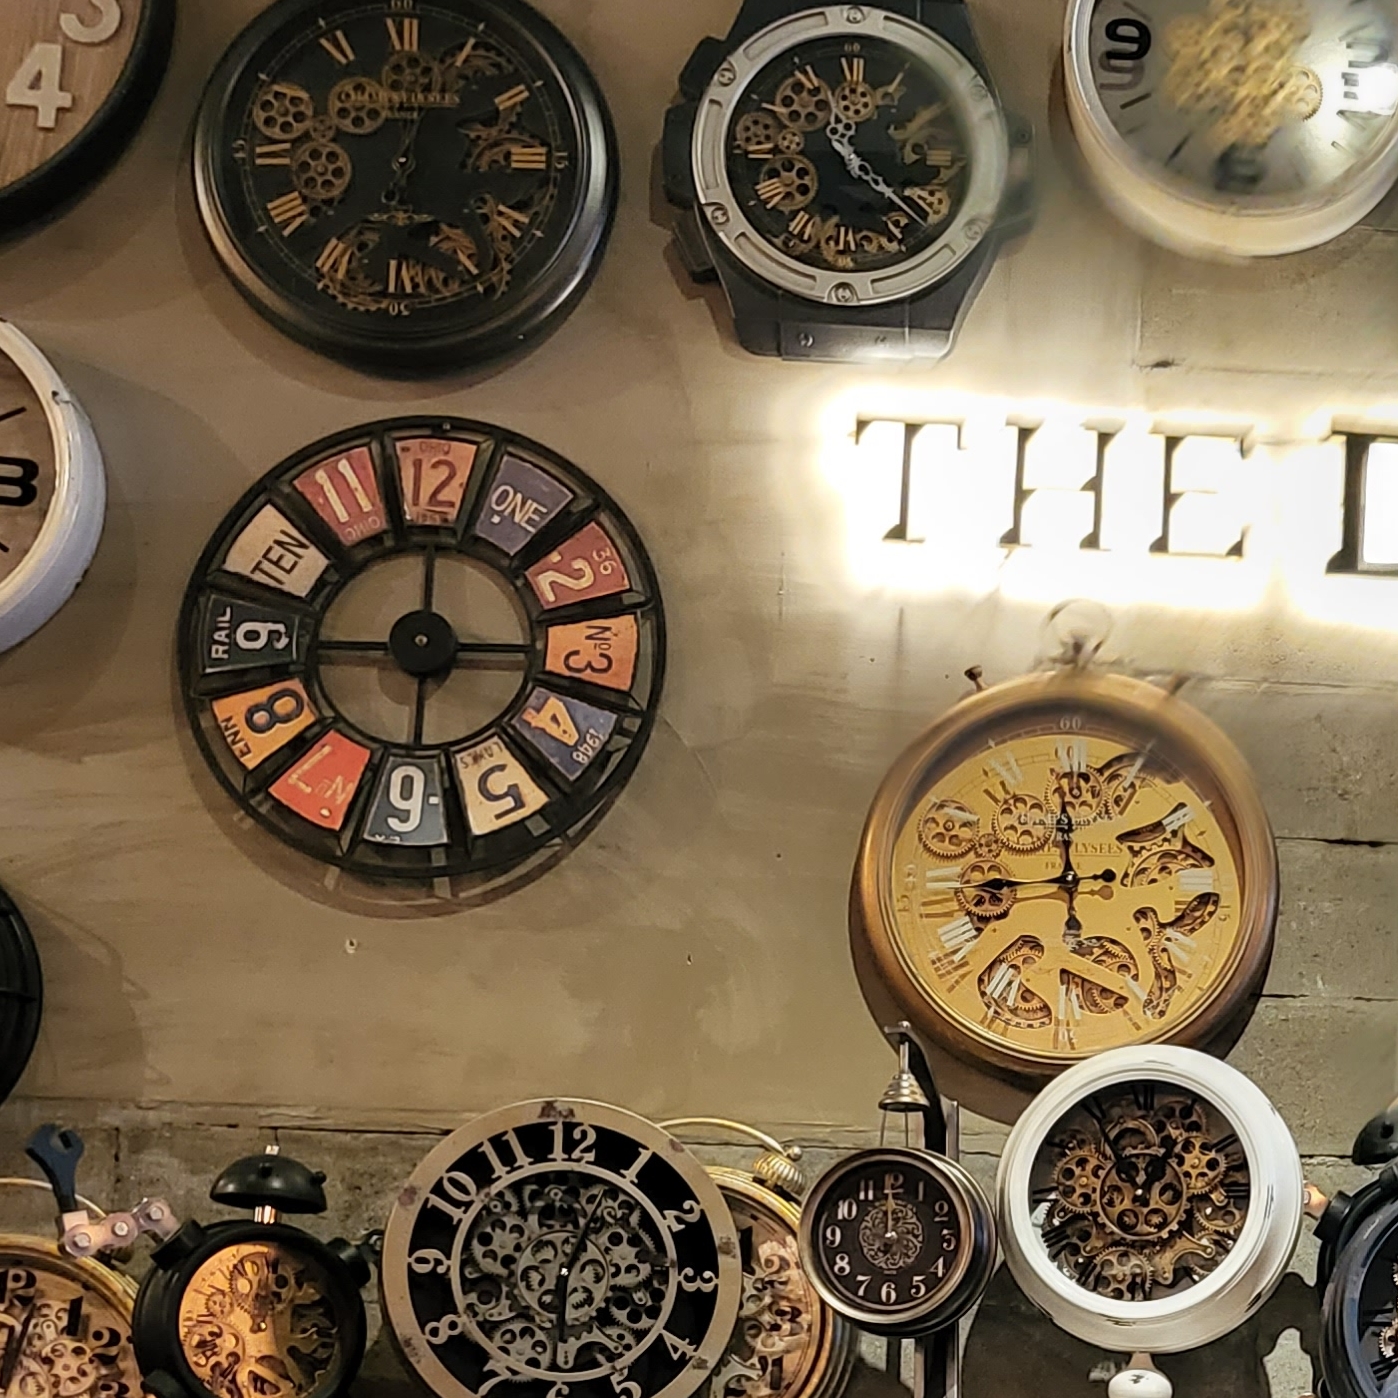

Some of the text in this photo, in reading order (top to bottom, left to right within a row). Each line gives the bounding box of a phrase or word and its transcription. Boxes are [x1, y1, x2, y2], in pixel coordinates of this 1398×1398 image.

[1105, 18, 1151, 60] 9
[6, 42, 73, 128] 4
[315, 458, 372, 522] 11
[412, 458, 457, 508] 12
[853, 411, 1250, 558] THE
[490, 485, 548, 533] ONE
[250, 529, 310, 585] TEN
[537, 558, 594, 603] 2
[211, 606, 232, 660] RAIL
[236, 621, 290, 650] 9
[563, 649, 613, 674] 3
[245, 688, 304, 734] 8
[521, 697, 579, 747] 4
[477, 763, 526, 821] 5
[478, 1129, 534, 1179] 11
[548, 1121, 597, 1163] 12
[621, 1147, 652, 1183] 1
[427, 1171, 478, 1225] 10
[859, 1179, 874, 1201] 11
[663, 1201, 701, 1232] 2
[837, 1199, 857, 1220] 10
[934, 1200, 949, 1222] 2
[825, 1225, 841, 1247] 9
[409, 1248, 449, 1274] 9
[834, 1253, 850, 1276] 8
[929, 1256, 946, 1278] 4
[679, 1267, 718, 1293] 3
[856, 1275, 872, 1297] 7
[881, 1281, 896, 1304] 6
[910, 1275, 926, 1298] 5
[425, 1314, 462, 1344] 8
[661, 1330, 697, 1361] 4
[478, 1358, 511, 1397] 7
